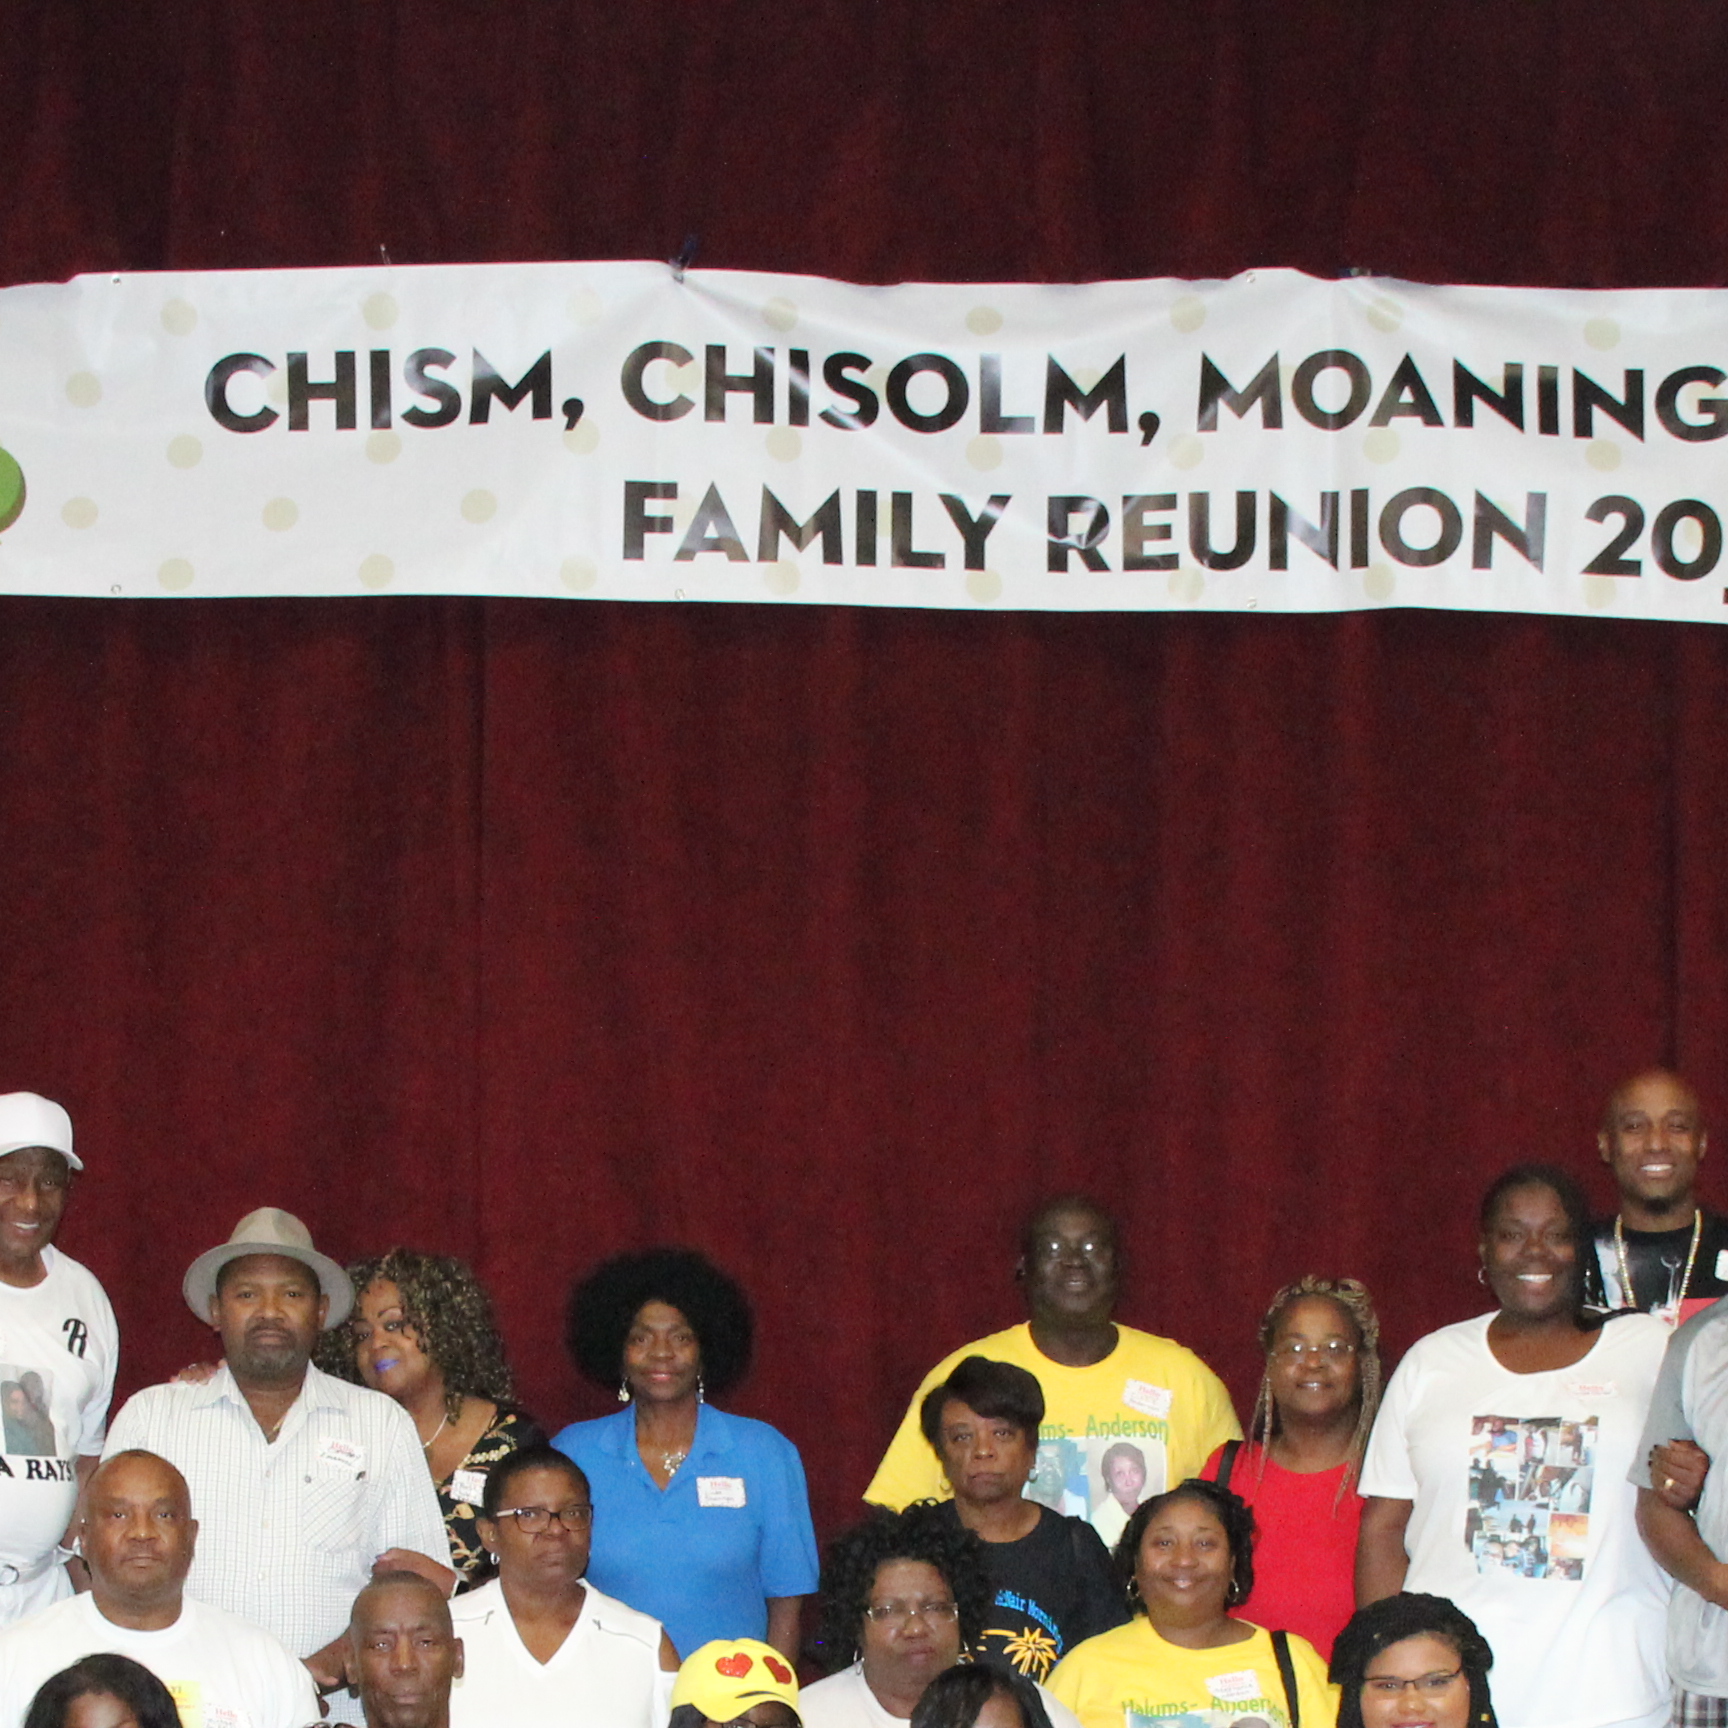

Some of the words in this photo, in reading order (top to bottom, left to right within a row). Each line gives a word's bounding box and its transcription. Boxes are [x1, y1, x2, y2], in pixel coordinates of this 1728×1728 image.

[204, 348, 586, 434] CHISM,
[620, 340, 1161, 446] CHISOLM,
[622, 479, 1013, 571] FAMILY
[1046, 490, 1548, 574] REUNION
